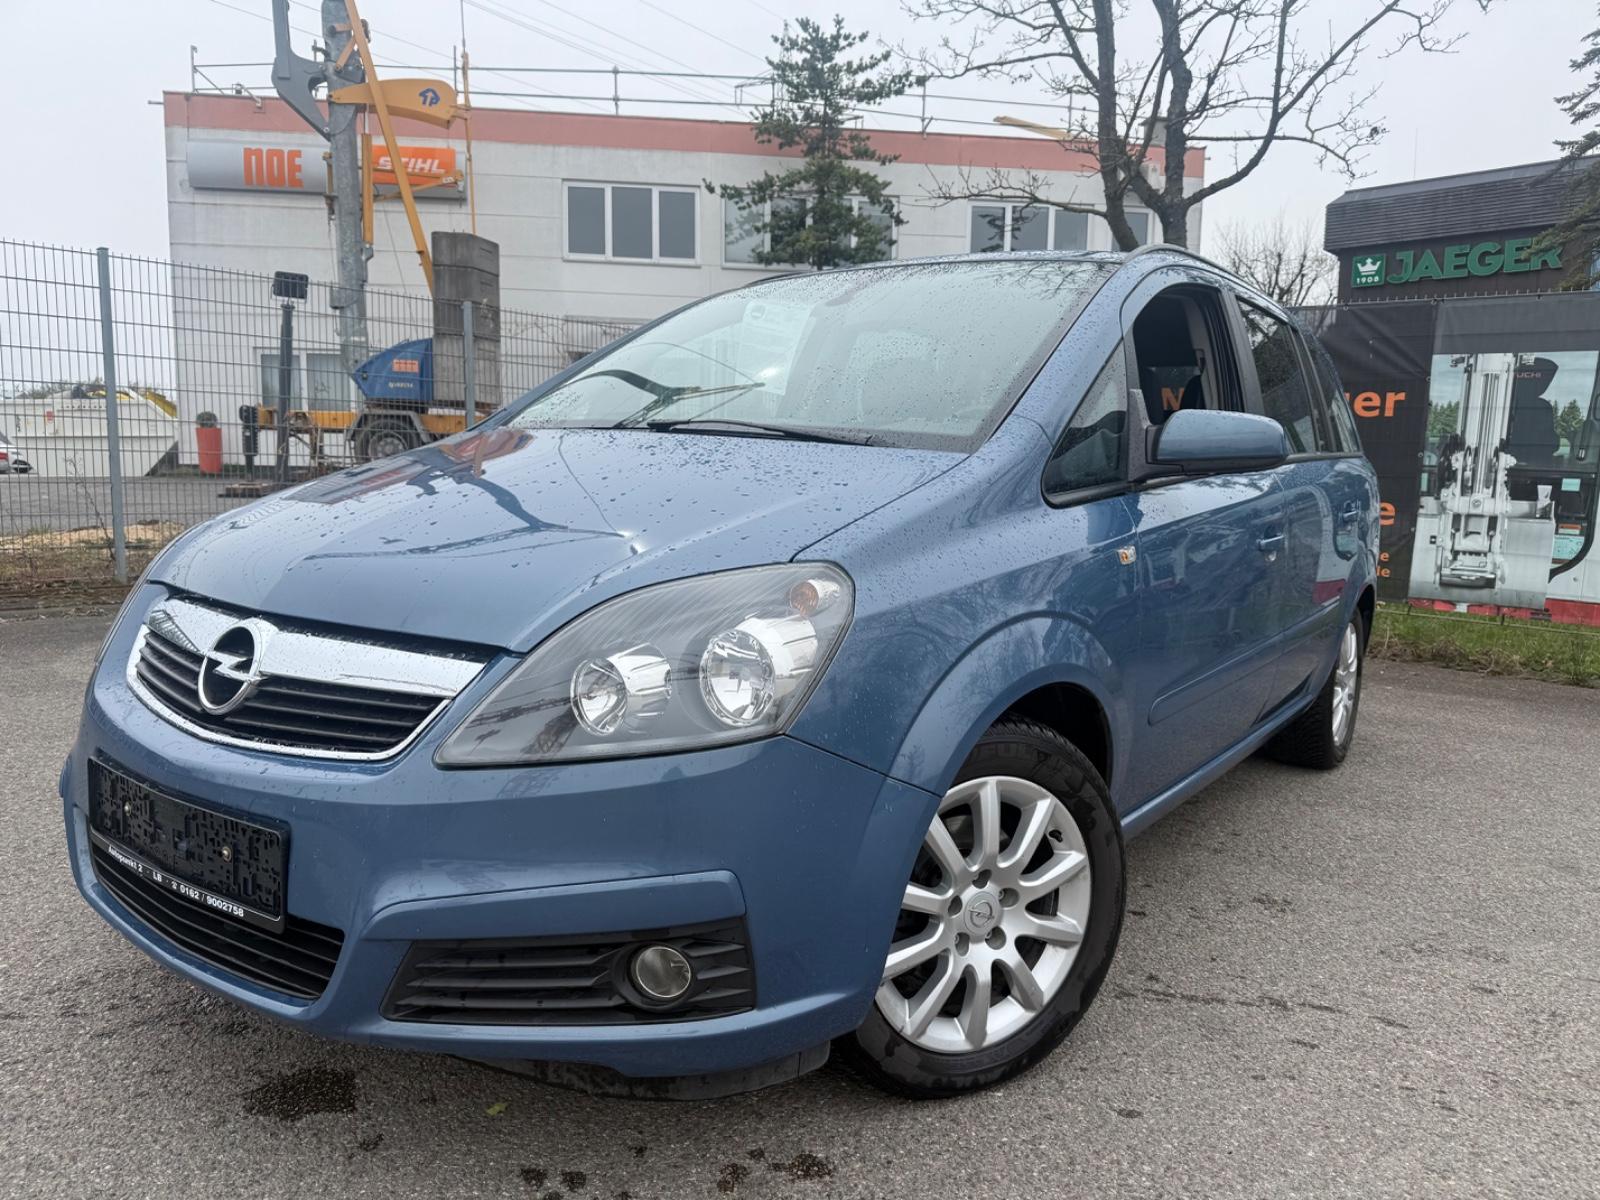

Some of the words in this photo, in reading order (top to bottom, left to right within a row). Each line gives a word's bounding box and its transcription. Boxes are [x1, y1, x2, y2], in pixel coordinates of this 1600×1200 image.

[243, 147, 304, 188] NOE
[1386, 238, 1563, 284] JAEGER
[1343, 391, 1406, 417] er
[108, 845, 138, 869] Autopunkt
[152, 872, 163, 882] LB
[180, 885, 200, 900] 0162
[206, 897, 244, 917] 9002758
